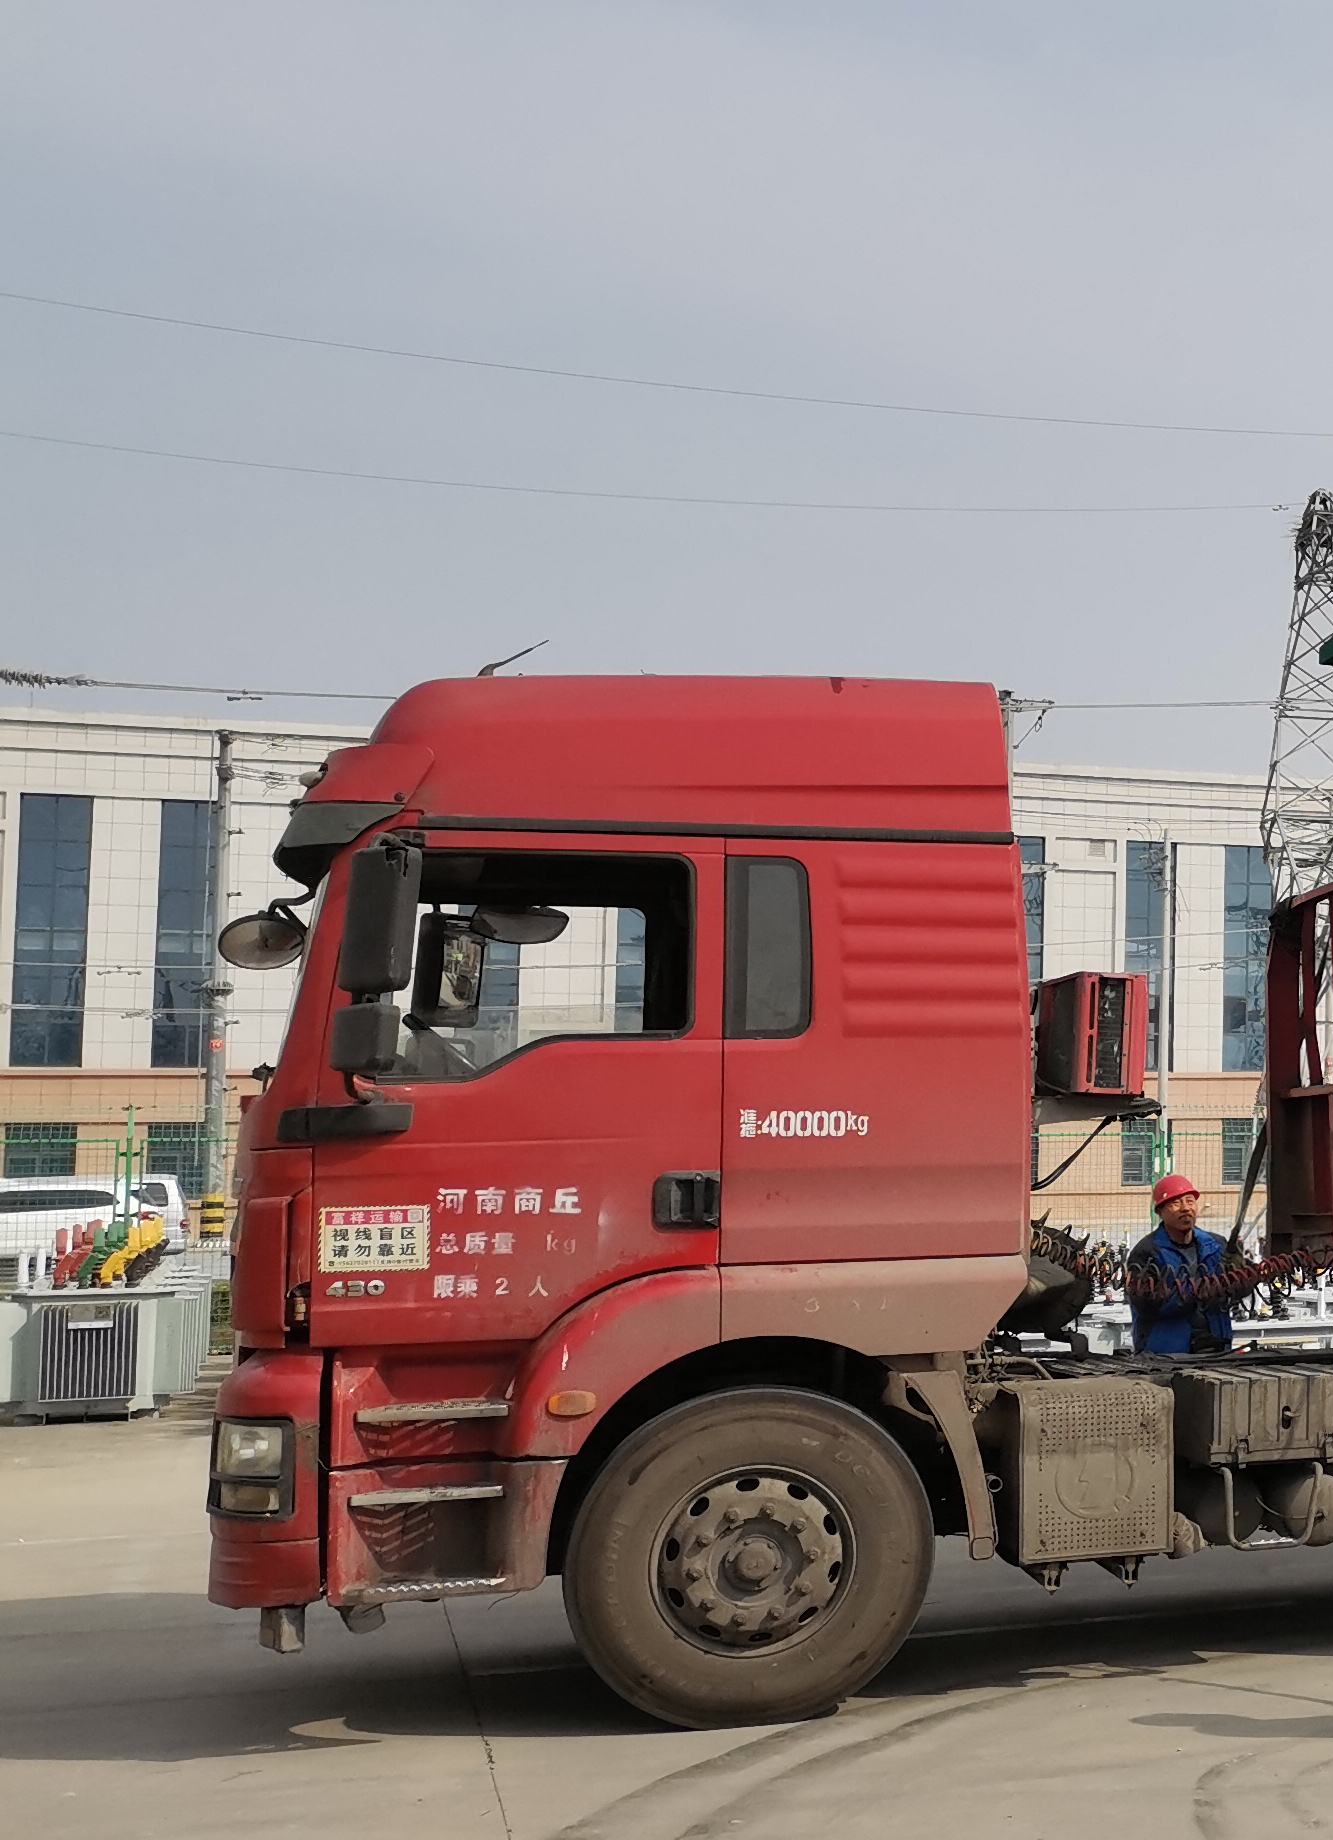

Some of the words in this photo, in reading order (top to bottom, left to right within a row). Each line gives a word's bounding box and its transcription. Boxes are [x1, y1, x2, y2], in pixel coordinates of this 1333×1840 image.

[436, 1187, 582, 1215] 河南商丘
[331, 1211, 403, 1225] 富祥运输
[331, 1227, 416, 1241] 视线盲区
[435, 1232, 516, 1255] 总质量
[546, 1230, 576, 1255] kg
[331, 1243, 416, 1258] 请勿靠近
[326, 1280, 385, 1297] 430
[495, 1277, 510, 1296] 2
[528, 1275, 549, 1298] 人
